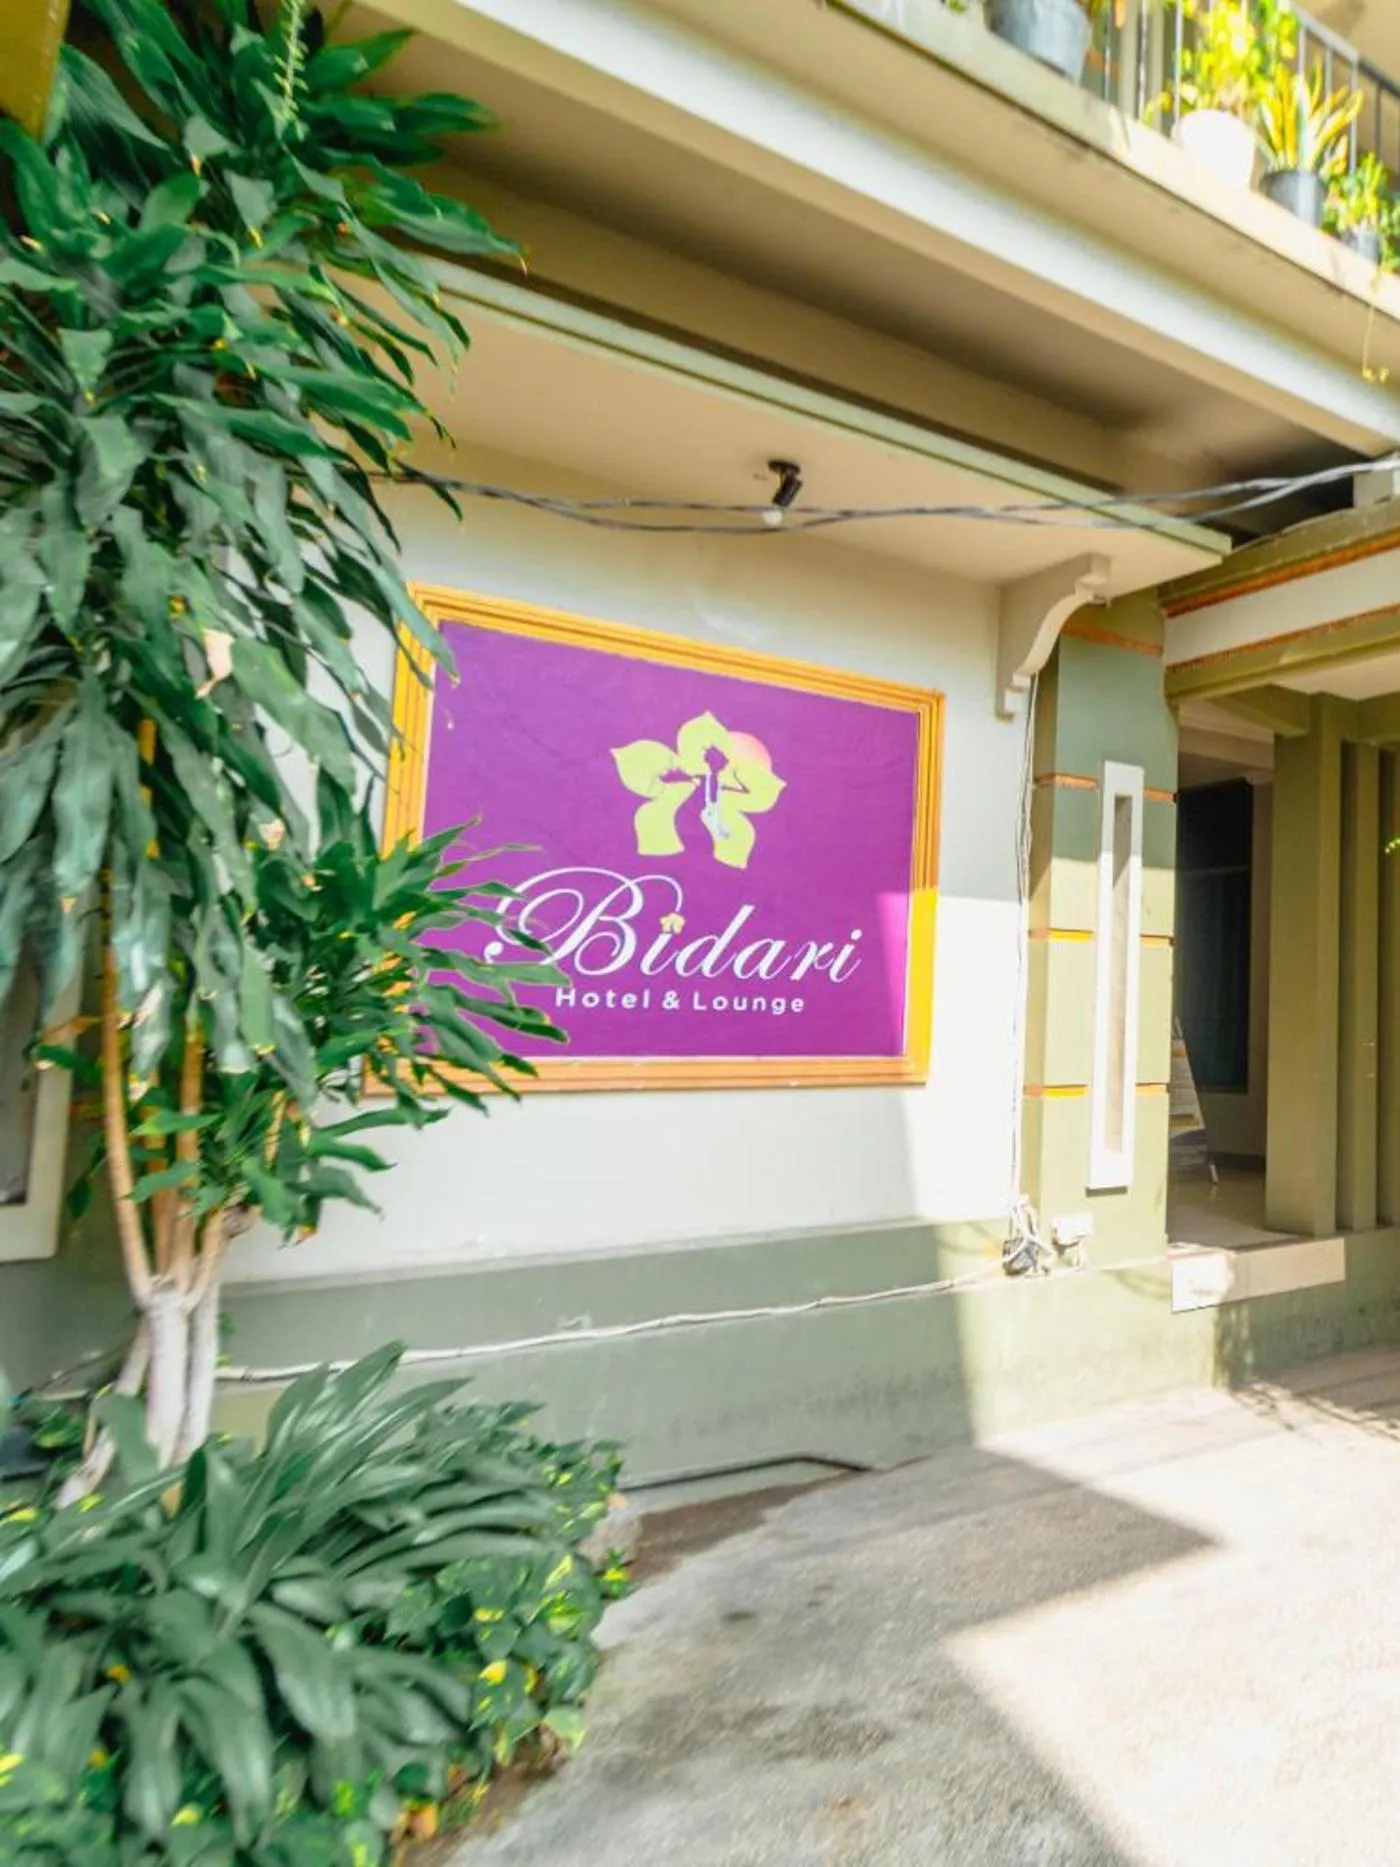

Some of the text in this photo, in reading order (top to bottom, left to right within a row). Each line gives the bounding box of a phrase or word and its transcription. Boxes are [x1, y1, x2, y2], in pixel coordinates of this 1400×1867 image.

[482, 867, 864, 984] Bidari
[554, 987, 805, 1015] Hotel & Lounge
